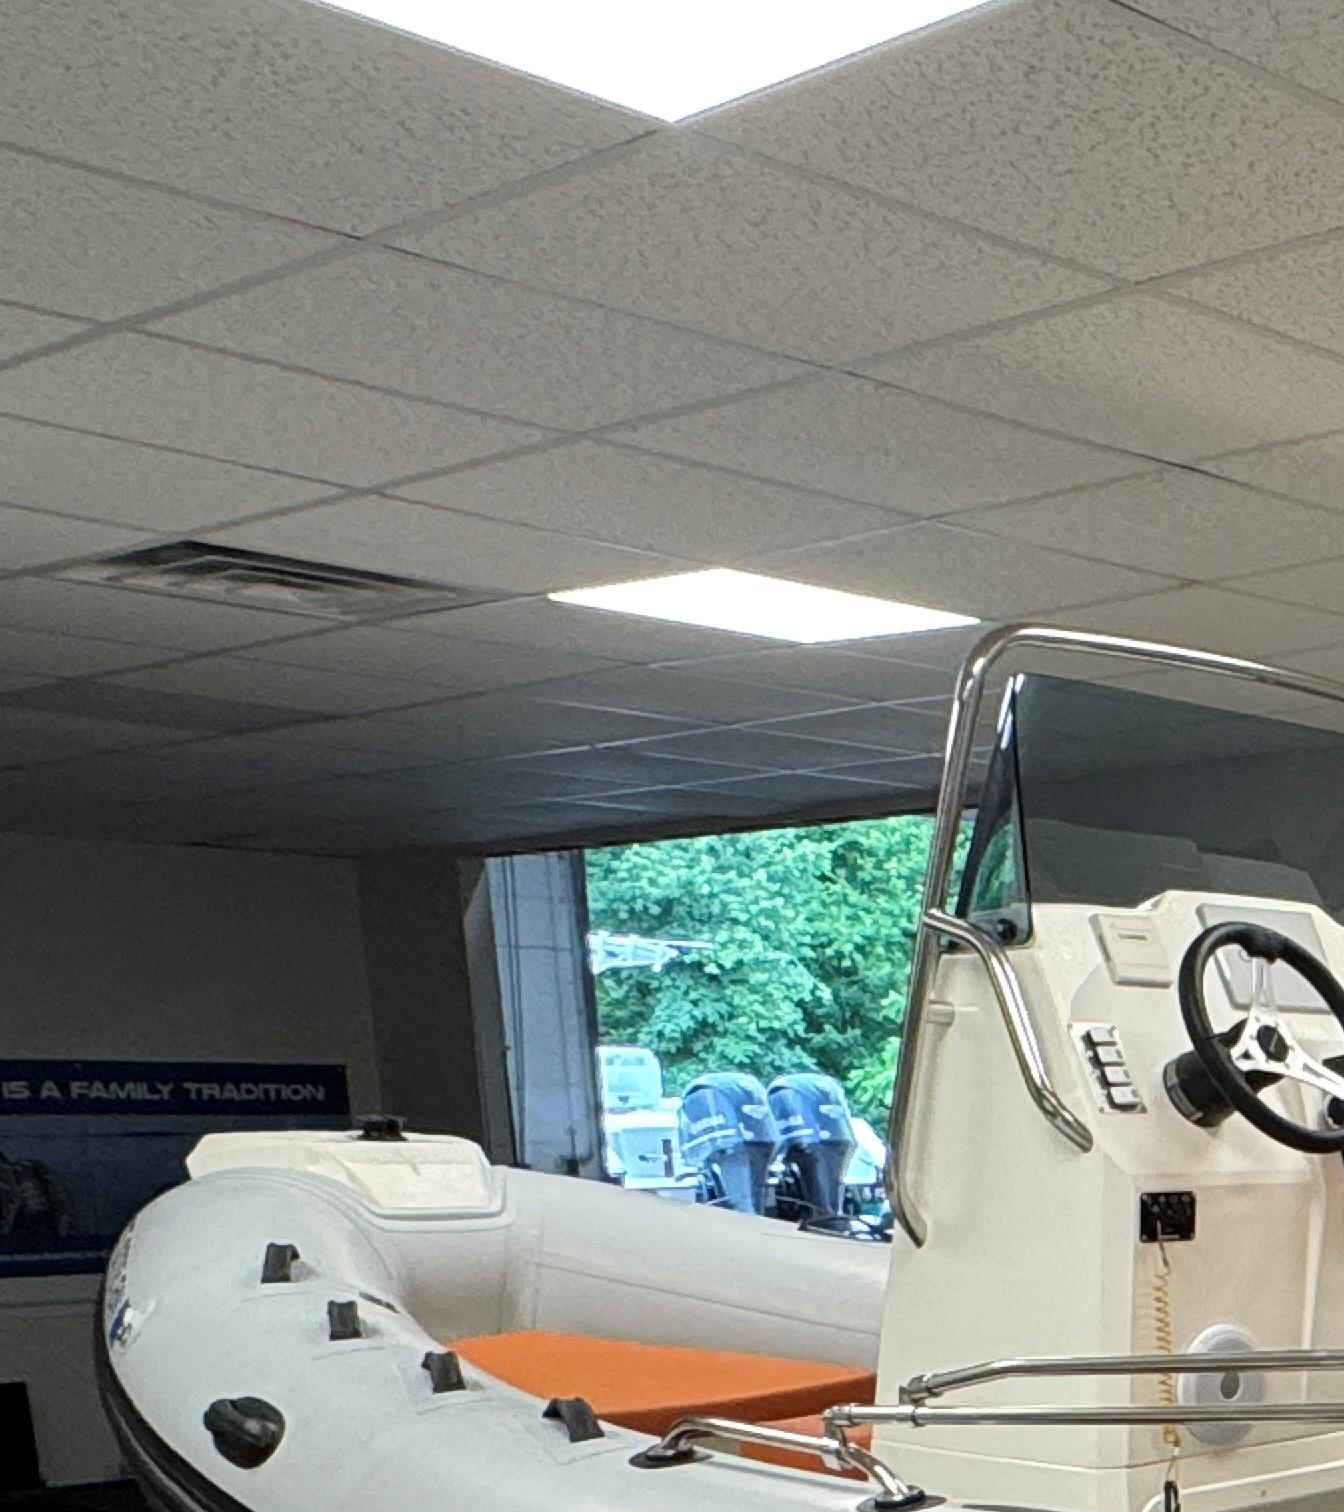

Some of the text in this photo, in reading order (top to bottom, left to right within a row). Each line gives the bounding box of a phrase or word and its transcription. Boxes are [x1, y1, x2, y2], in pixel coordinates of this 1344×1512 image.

[1, 1080, 325, 1101] IS A FAMILY TRADITION
